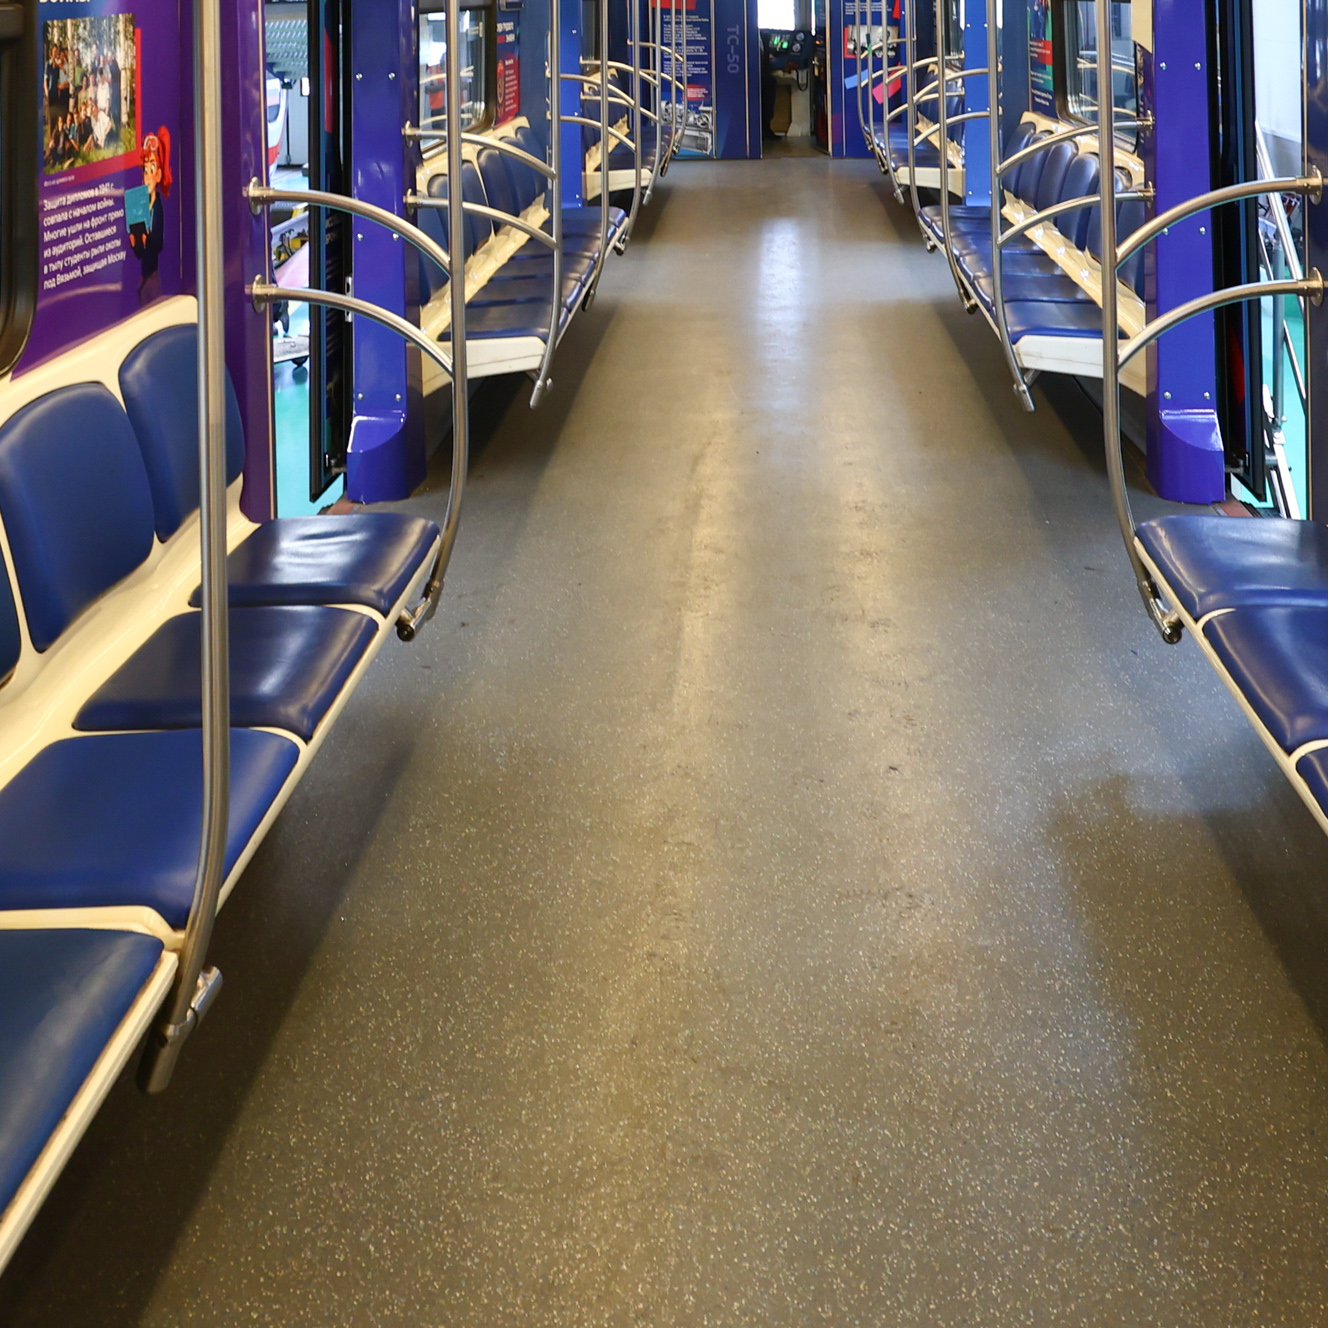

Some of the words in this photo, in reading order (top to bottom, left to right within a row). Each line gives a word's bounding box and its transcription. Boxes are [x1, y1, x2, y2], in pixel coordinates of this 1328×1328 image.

[43, 196, 66, 211] Защита
[43, 210, 68, 227] совпала
[43, 227, 67, 243] Многие
[90, 213, 107, 229] фронт
[107, 209, 124, 222] прямо
[43, 249, 51, 258] из
[64, 249, 90, 267] студенты
[105, 239, 122, 251] окопы
[43, 278, 56, 290] под
[107, 251, 127, 264] Москву
